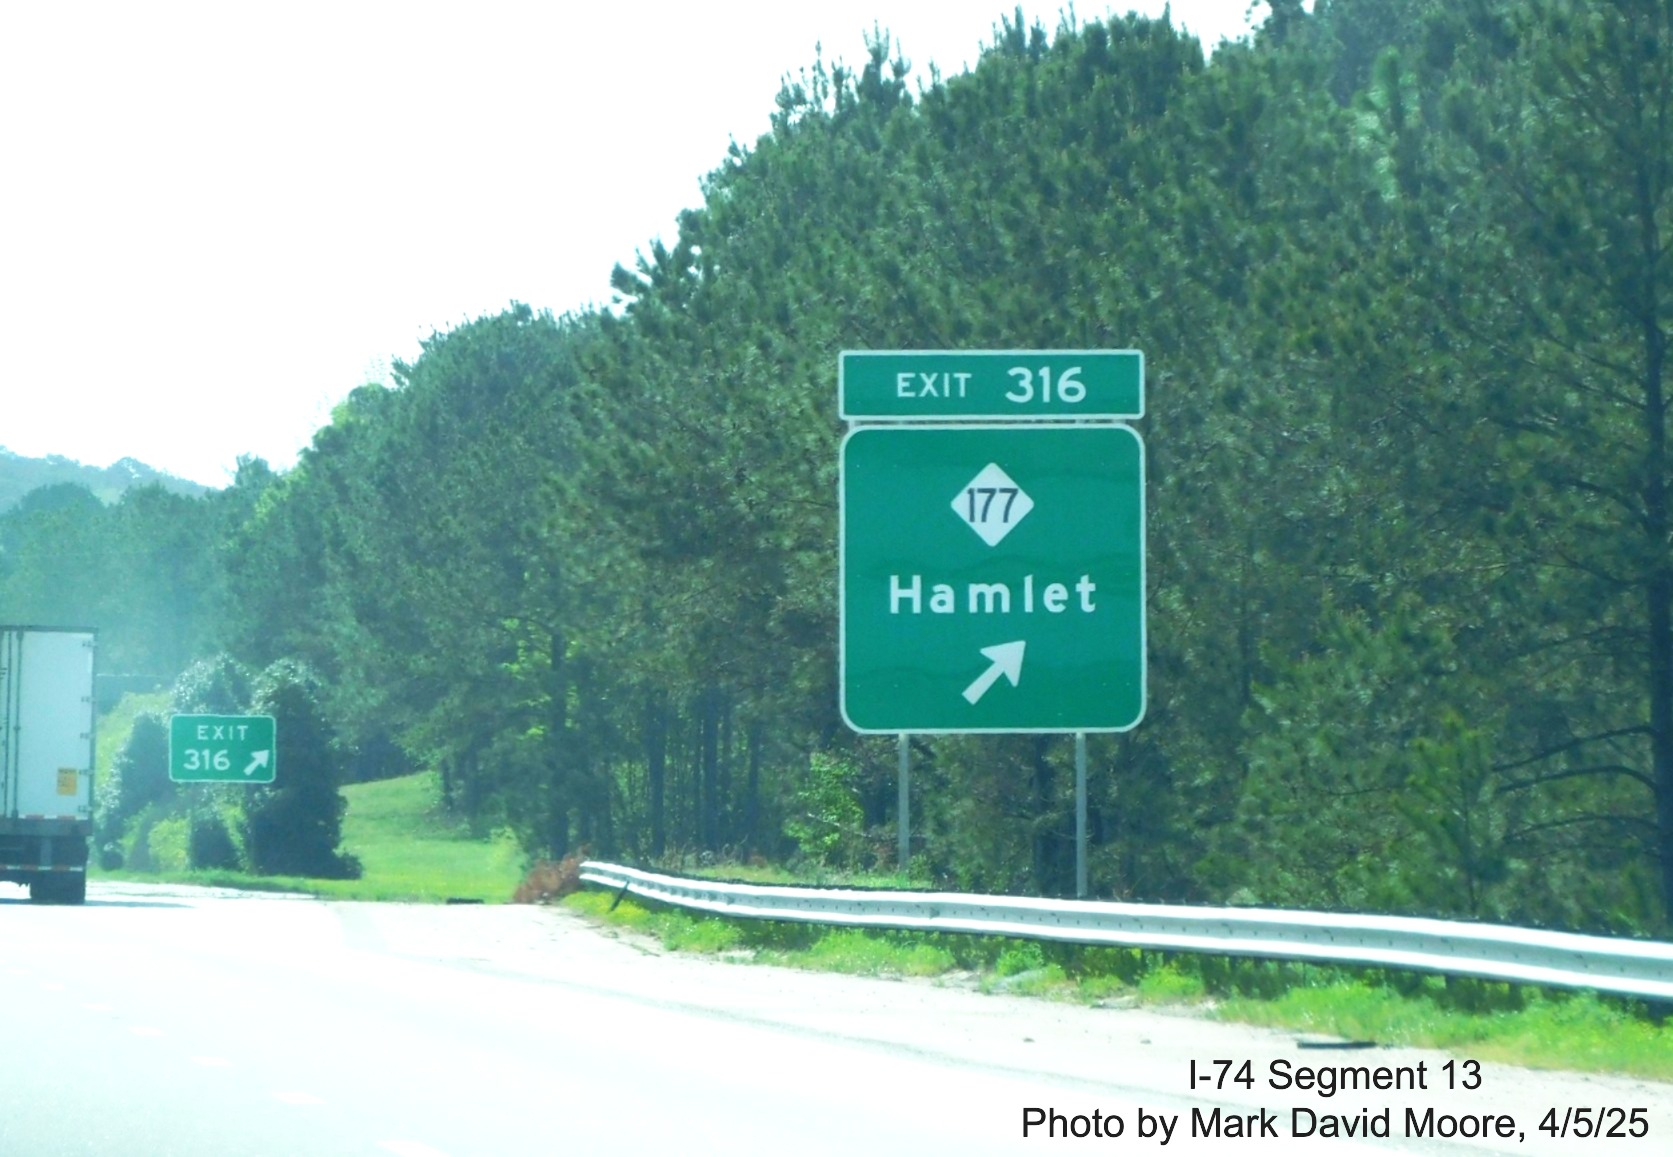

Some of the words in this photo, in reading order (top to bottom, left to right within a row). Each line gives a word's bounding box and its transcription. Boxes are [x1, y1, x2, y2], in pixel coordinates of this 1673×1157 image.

[896, 372, 972, 398] EXIT
[1005, 366, 1087, 403] 316
[966, 487, 1019, 523] 177
[889, 574, 1096, 614] Hamlet
[197, 725, 249, 741] EXIT
[183, 748, 231, 771] 316
